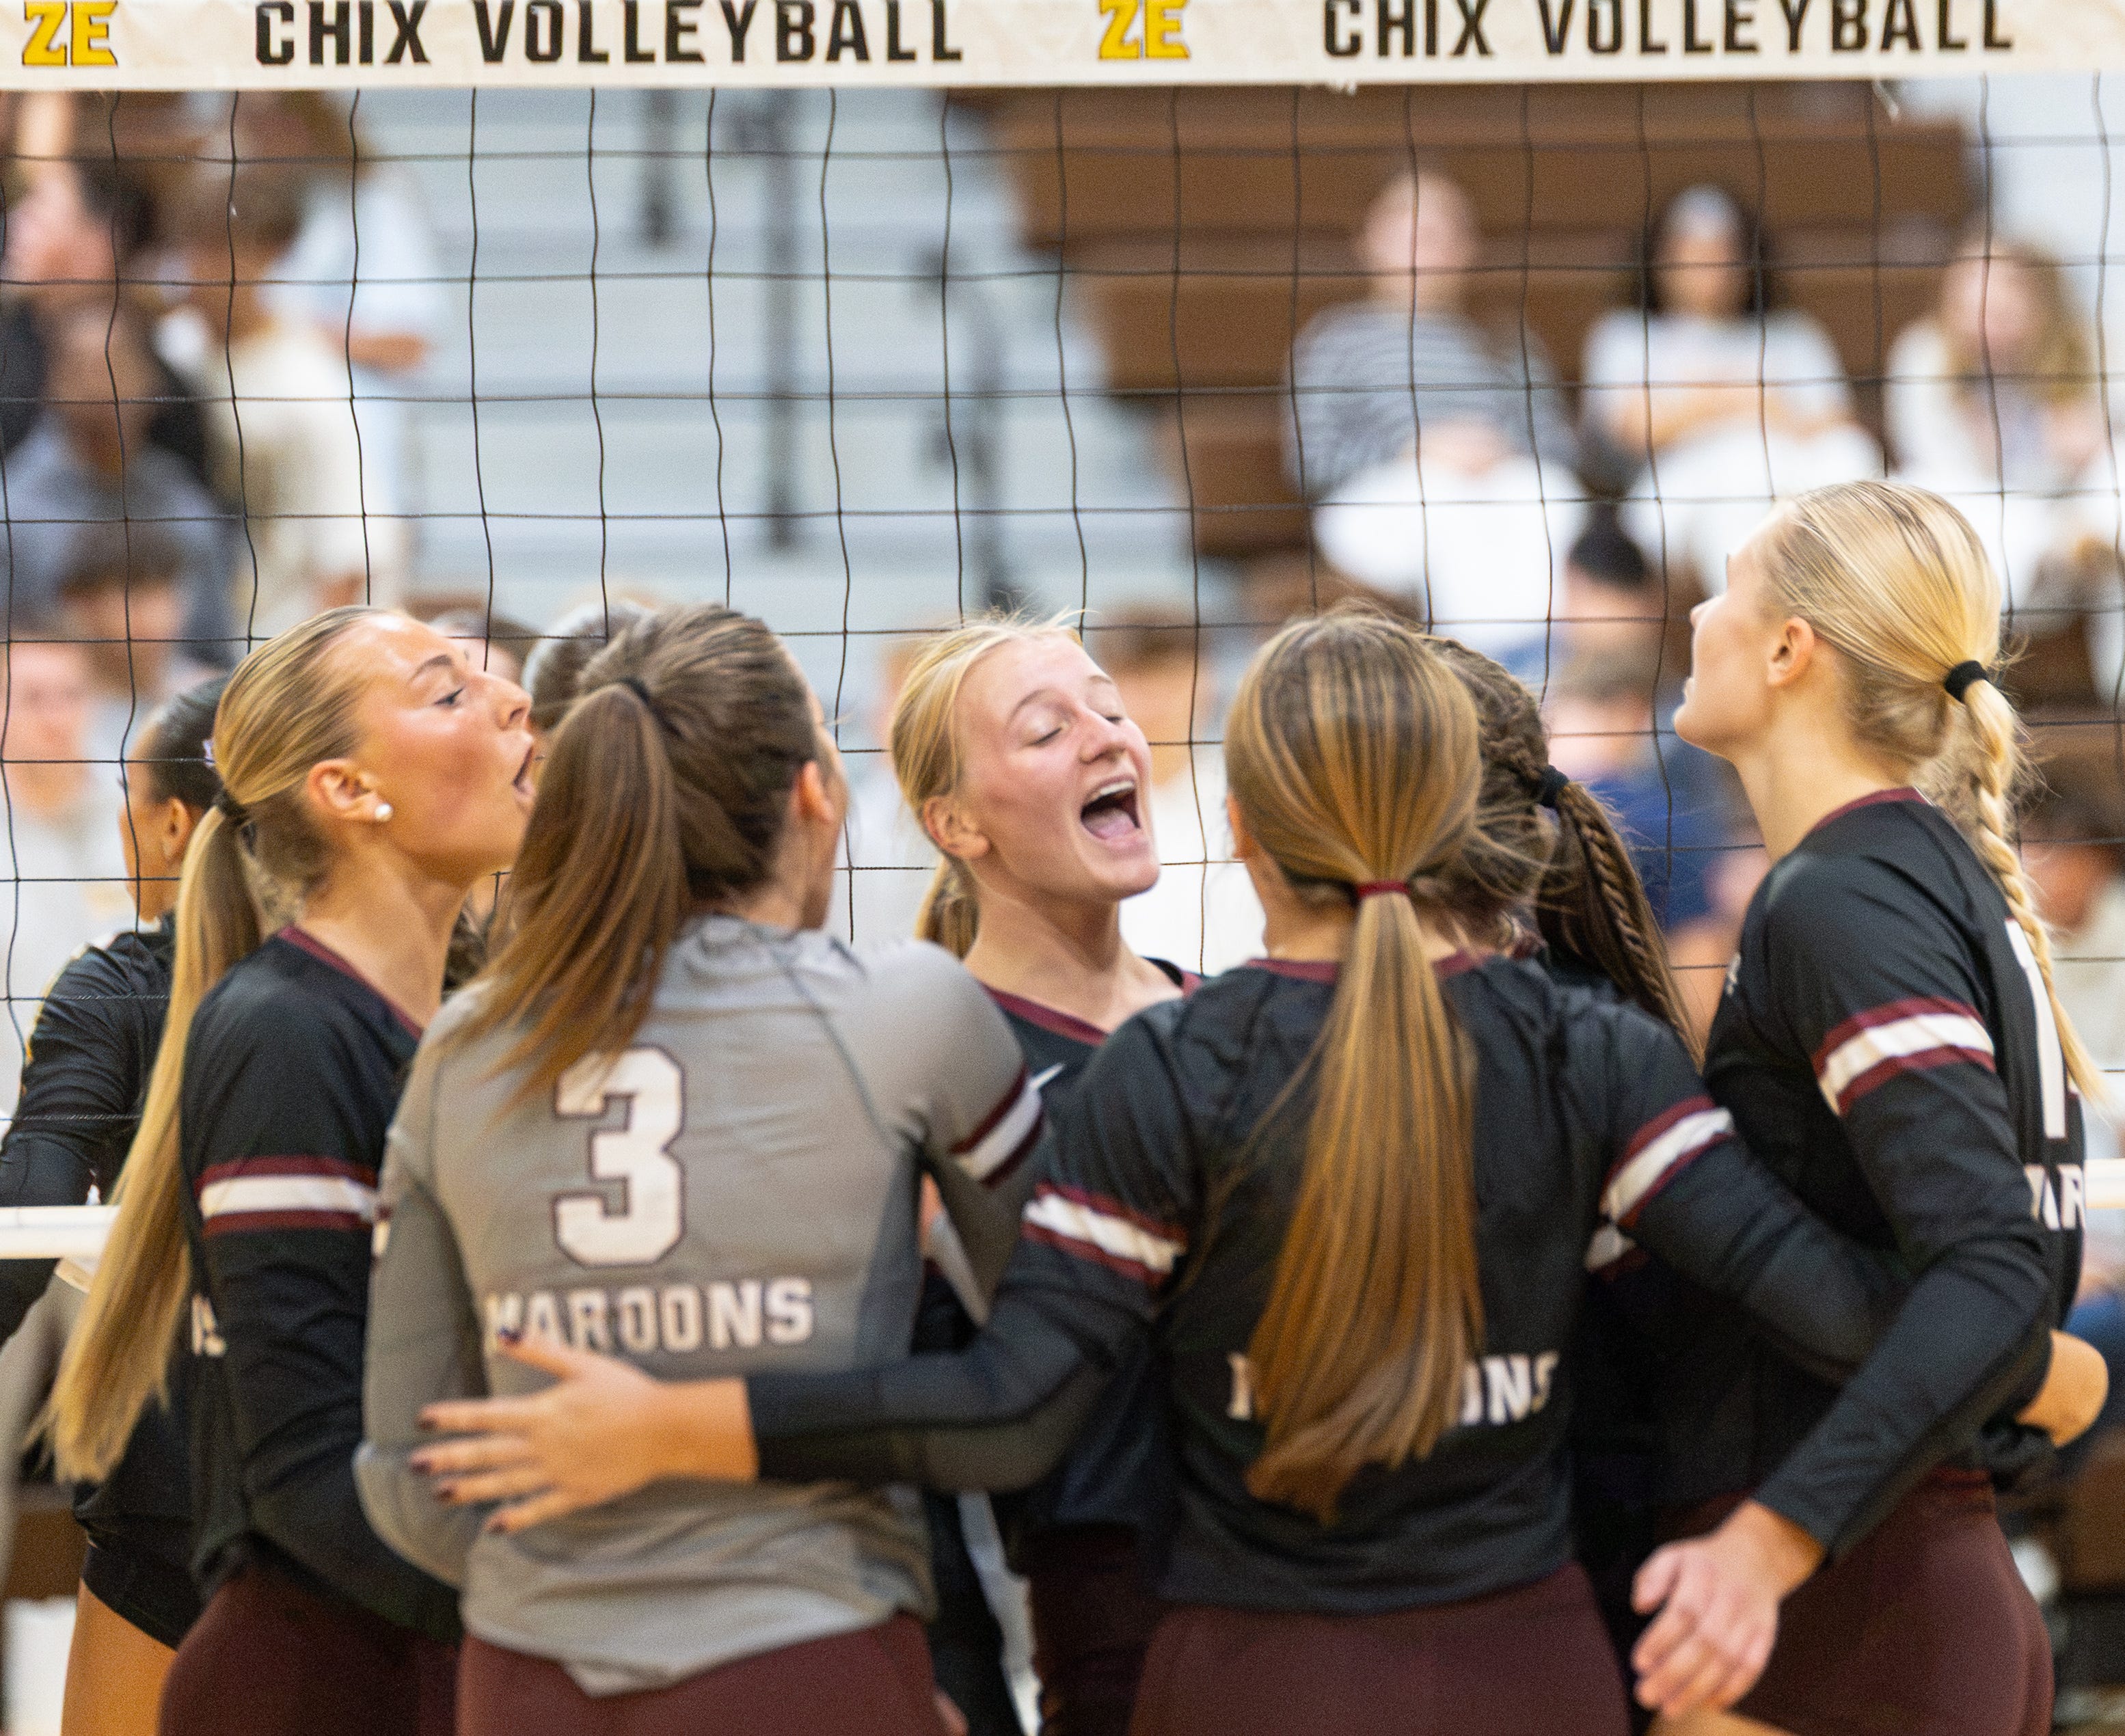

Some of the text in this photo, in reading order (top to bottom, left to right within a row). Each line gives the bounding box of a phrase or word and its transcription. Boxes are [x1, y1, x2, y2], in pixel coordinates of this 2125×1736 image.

[21, 1, 118, 66] ZE
[255, 0, 964, 66] CHIX VOLLEYBALL
[1098, 0, 1191, 60] ZE
[1322, 0, 2014, 57] CHIX VOLLEYBALL
[552, 1044, 686, 1269] 3
